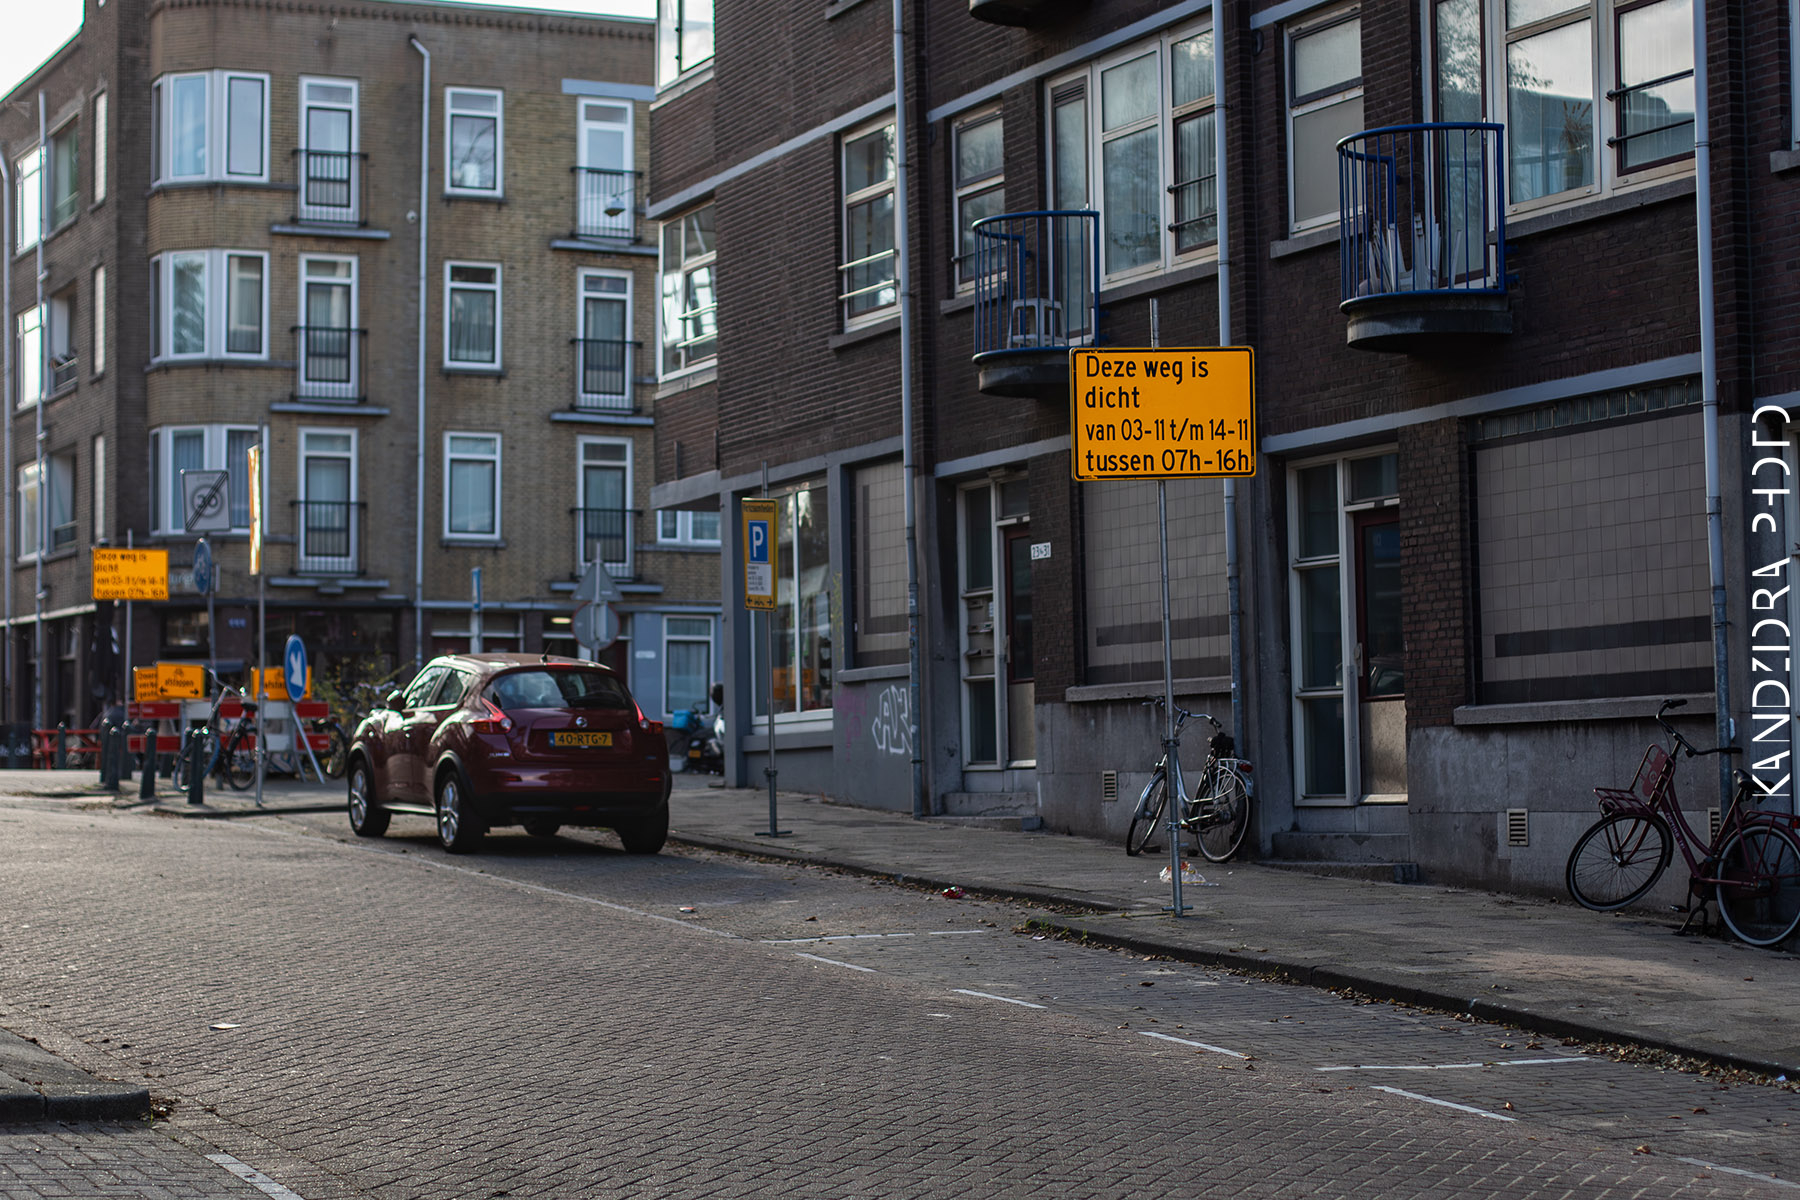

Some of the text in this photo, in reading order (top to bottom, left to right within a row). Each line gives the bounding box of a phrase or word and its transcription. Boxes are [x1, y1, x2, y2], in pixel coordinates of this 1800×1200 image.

[1086, 355, 1209, 385] Deze weg is
[1085, 386, 1140, 408] dicht
[1085, 417, 1248, 442] van 03-11 t/m 14-11
[1085, 450, 1154, 471] tussen
[752, 525, 764, 558] P
[558, 733, 608, 745] 40-RTG-7
